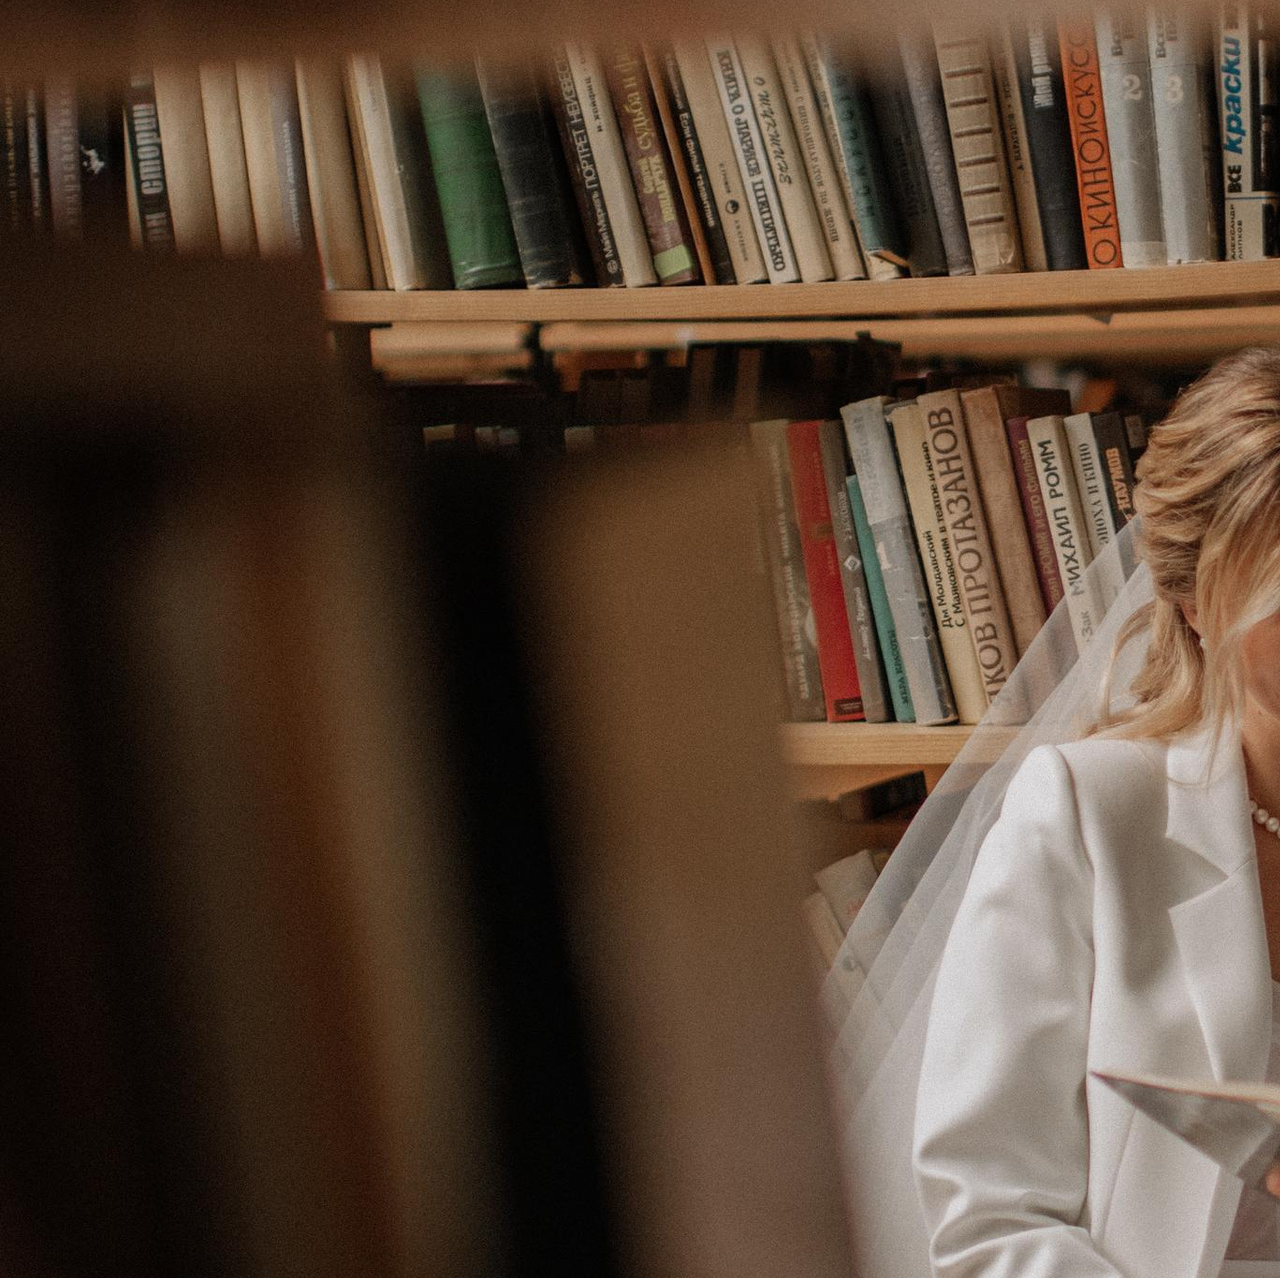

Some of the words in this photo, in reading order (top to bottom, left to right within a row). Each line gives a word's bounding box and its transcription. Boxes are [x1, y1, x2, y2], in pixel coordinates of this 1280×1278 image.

[717, 49, 736, 103] КНИГА
[1122, 74, 1142, 100] 2
[1166, 75, 1183, 105] 3
[1220, 36, 1246, 154] краски
[623, 92, 653, 150] судьба
[734, 104, 745, 115] О
[572, 128, 598, 190] ПОРТРЕТ
[736, 117, 761, 176] ЛАРИСЕ
[1227, 165, 1243, 193] ВСЕ
[755, 179, 786, 271] ШЕПИТЬКО
[1093, 239, 1117, 265] О
[1020, 439, 1040, 491] фильмы
[1037, 439, 1064, 498] РОММ
[1078, 443, 1096, 480] КИНО
[1105, 447, 1131, 509] НАУМОВ
[927, 406, 992, 615] ПРОТАЗАНОВ
[1031, 494, 1046, 516] его
[1087, 485, 1099, 493] И
[1037, 519, 1046, 528] и
[1090, 499, 1109, 545] ЭПОХА
[922, 530, 949, 607] Молдавский
[1036, 532, 1053, 573] РОММ
[1053, 507, 1084, 595] МИХАИЛ
[940, 537, 962, 614] Маяковским
[940, 609, 954, 628] Дм
[954, 618, 965, 627] С
[1080, 611, 1092, 636] Зак
[887, 629, 904, 673] КРАСОТЫ
[897, 676, 909, 705] МЕРА
